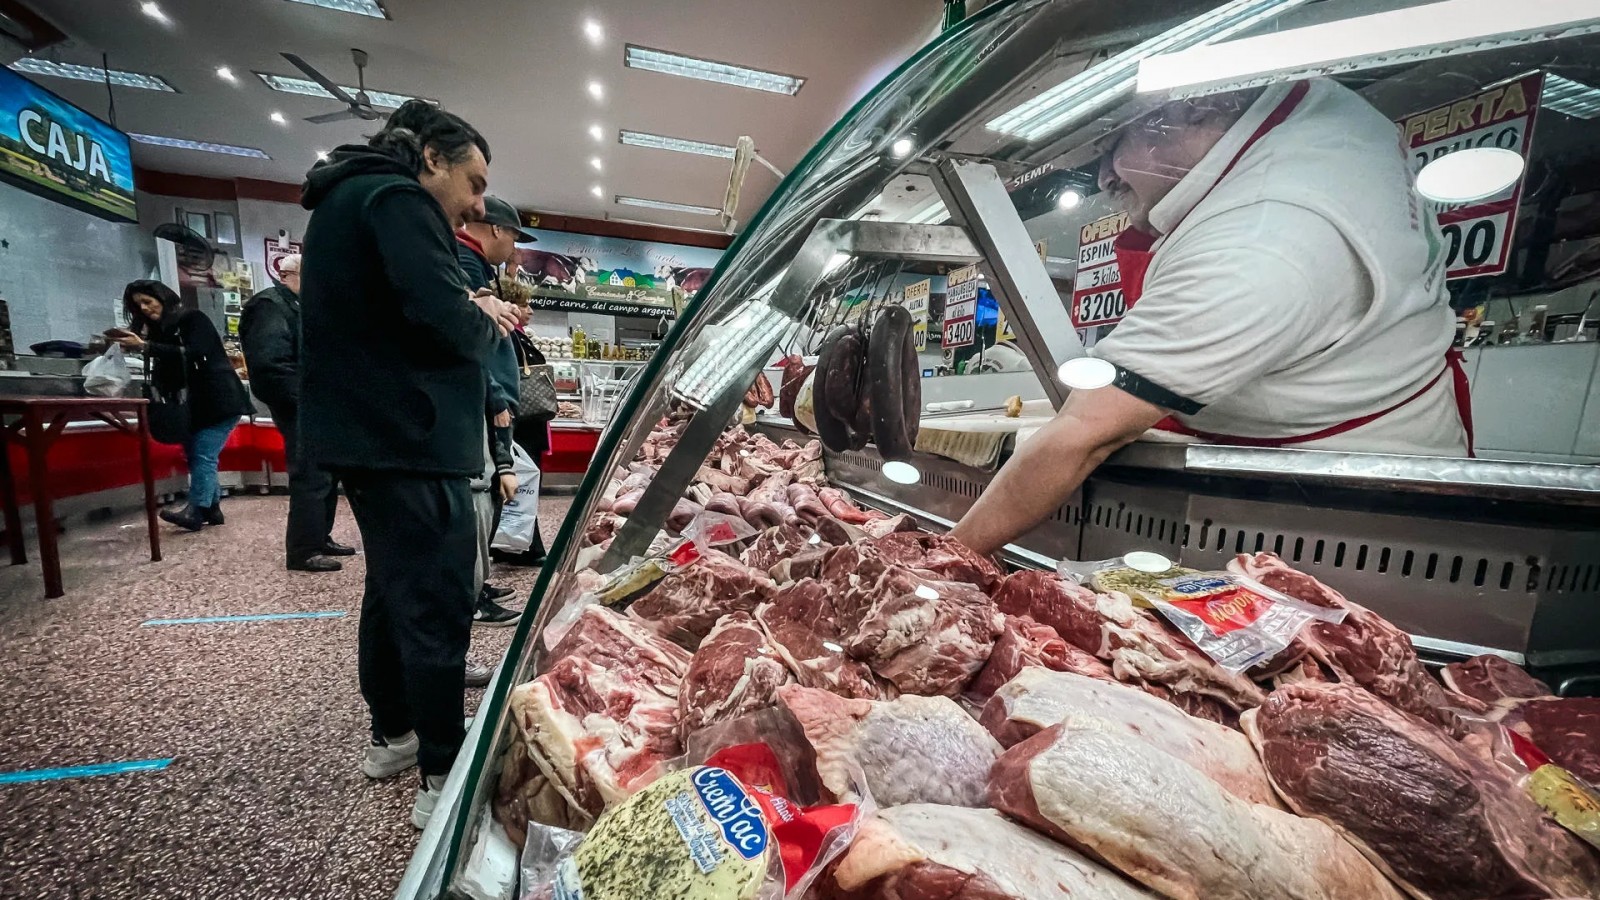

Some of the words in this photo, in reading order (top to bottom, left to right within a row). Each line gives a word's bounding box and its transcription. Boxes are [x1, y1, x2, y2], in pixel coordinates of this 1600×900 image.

[1399, 81, 1527, 146] FERTA
[18, 109, 112, 183] CAJA
[1092, 271, 1100, 287] 3
[1101, 267, 1120, 286] kilos
[906, 282, 928, 298] OFERTA
[527, 297, 557, 307] mejor
[560, 299, 589, 310] carne,
[592, 301, 607, 310] del
[608, 304, 639, 314] campo
[1080, 289, 1126, 322] 3200
[947, 321, 972, 344] 3400
